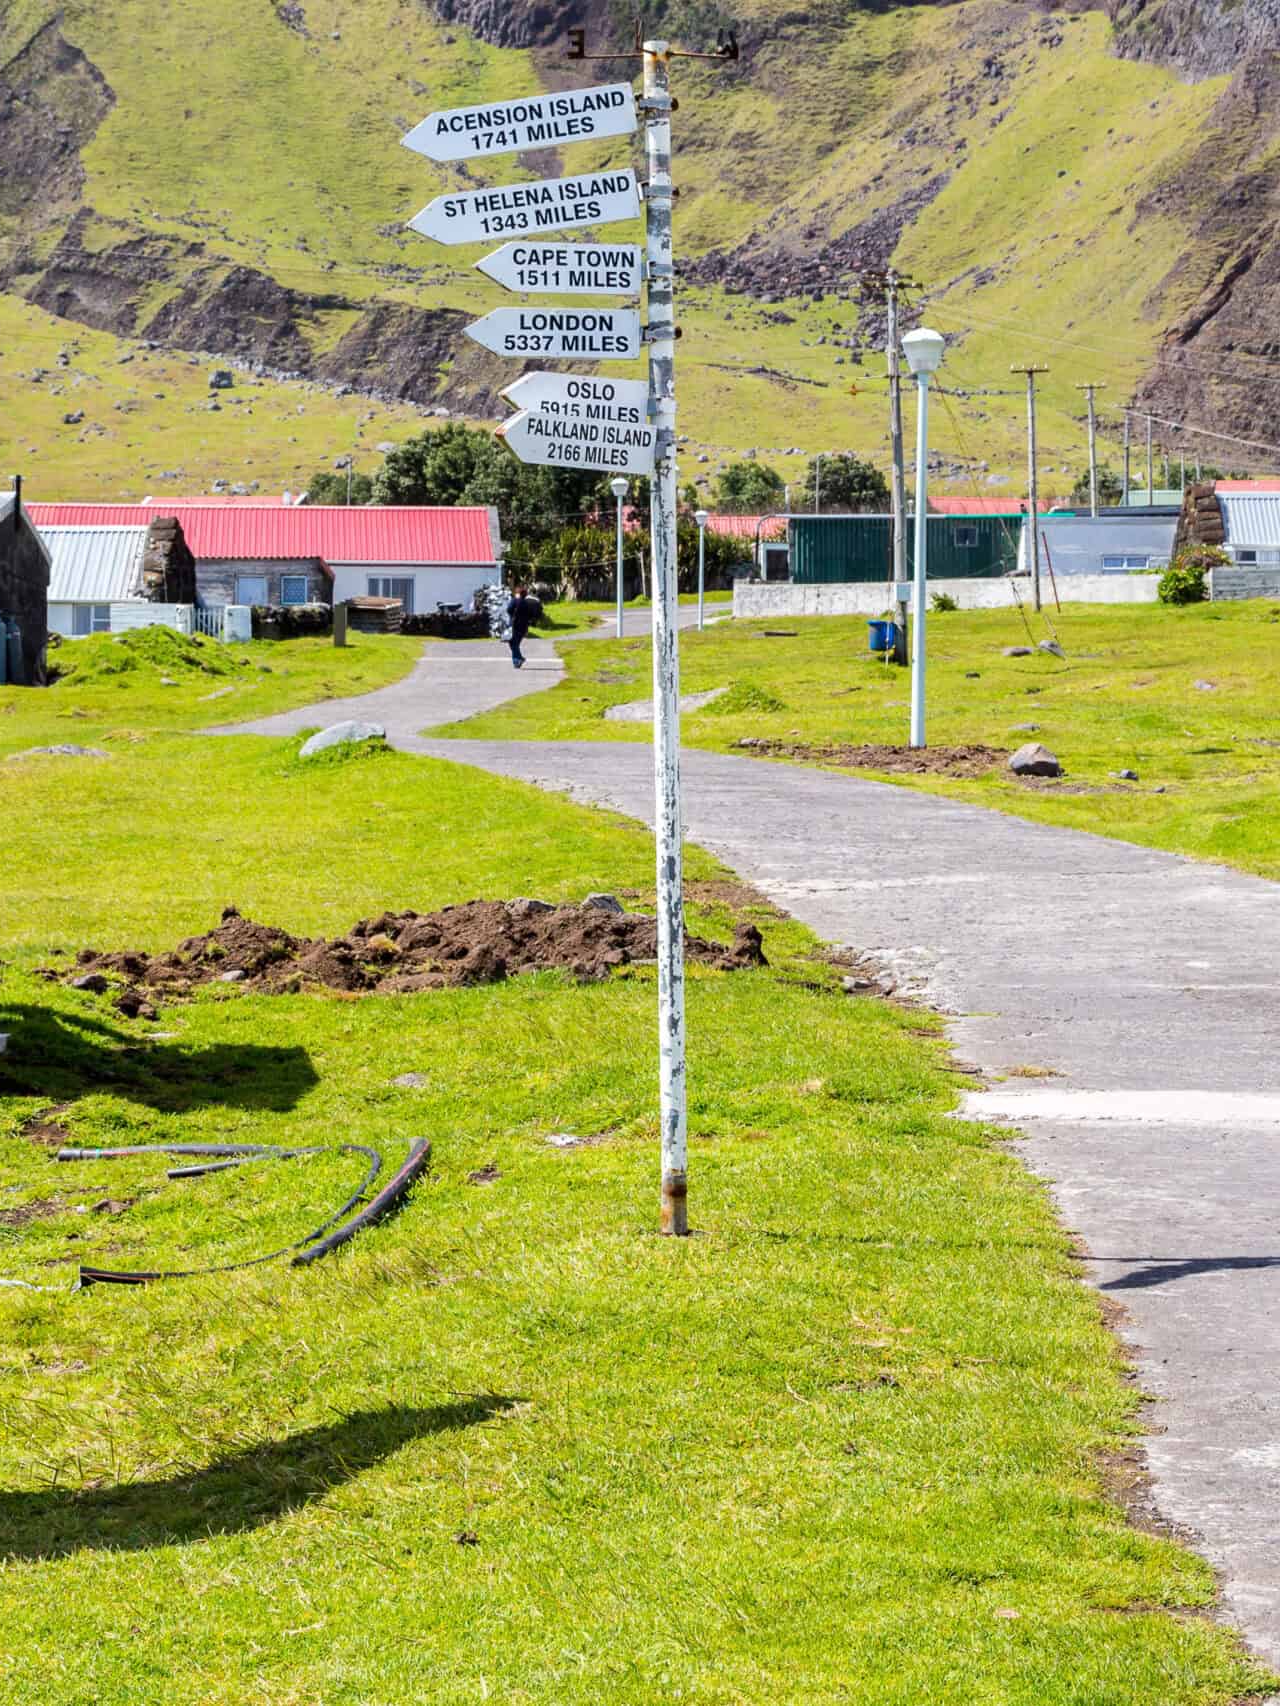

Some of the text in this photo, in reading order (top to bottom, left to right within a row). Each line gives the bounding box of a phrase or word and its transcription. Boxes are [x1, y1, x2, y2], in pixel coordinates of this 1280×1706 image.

[436, 90, 625, 135] ACENSION ISLAND
[471, 116, 595, 151] 1741 MILES
[444, 175, 630, 218] ST HELENA ISLAND
[480, 201, 601, 234] 1343 MILES
[513, 248, 635, 268] CAPE TOWN
[516, 270, 631, 288] 1511 MILES
[519, 314, 613, 331] LONDON
[504, 334, 629, 352] 5337 MILES
[567, 381, 615, 401] OSLO
[540, 401, 639, 423] 5915 MILES
[527, 418, 651, 447] FALKLAND ISLAND
[547, 442, 629, 466] 2166 MILES
